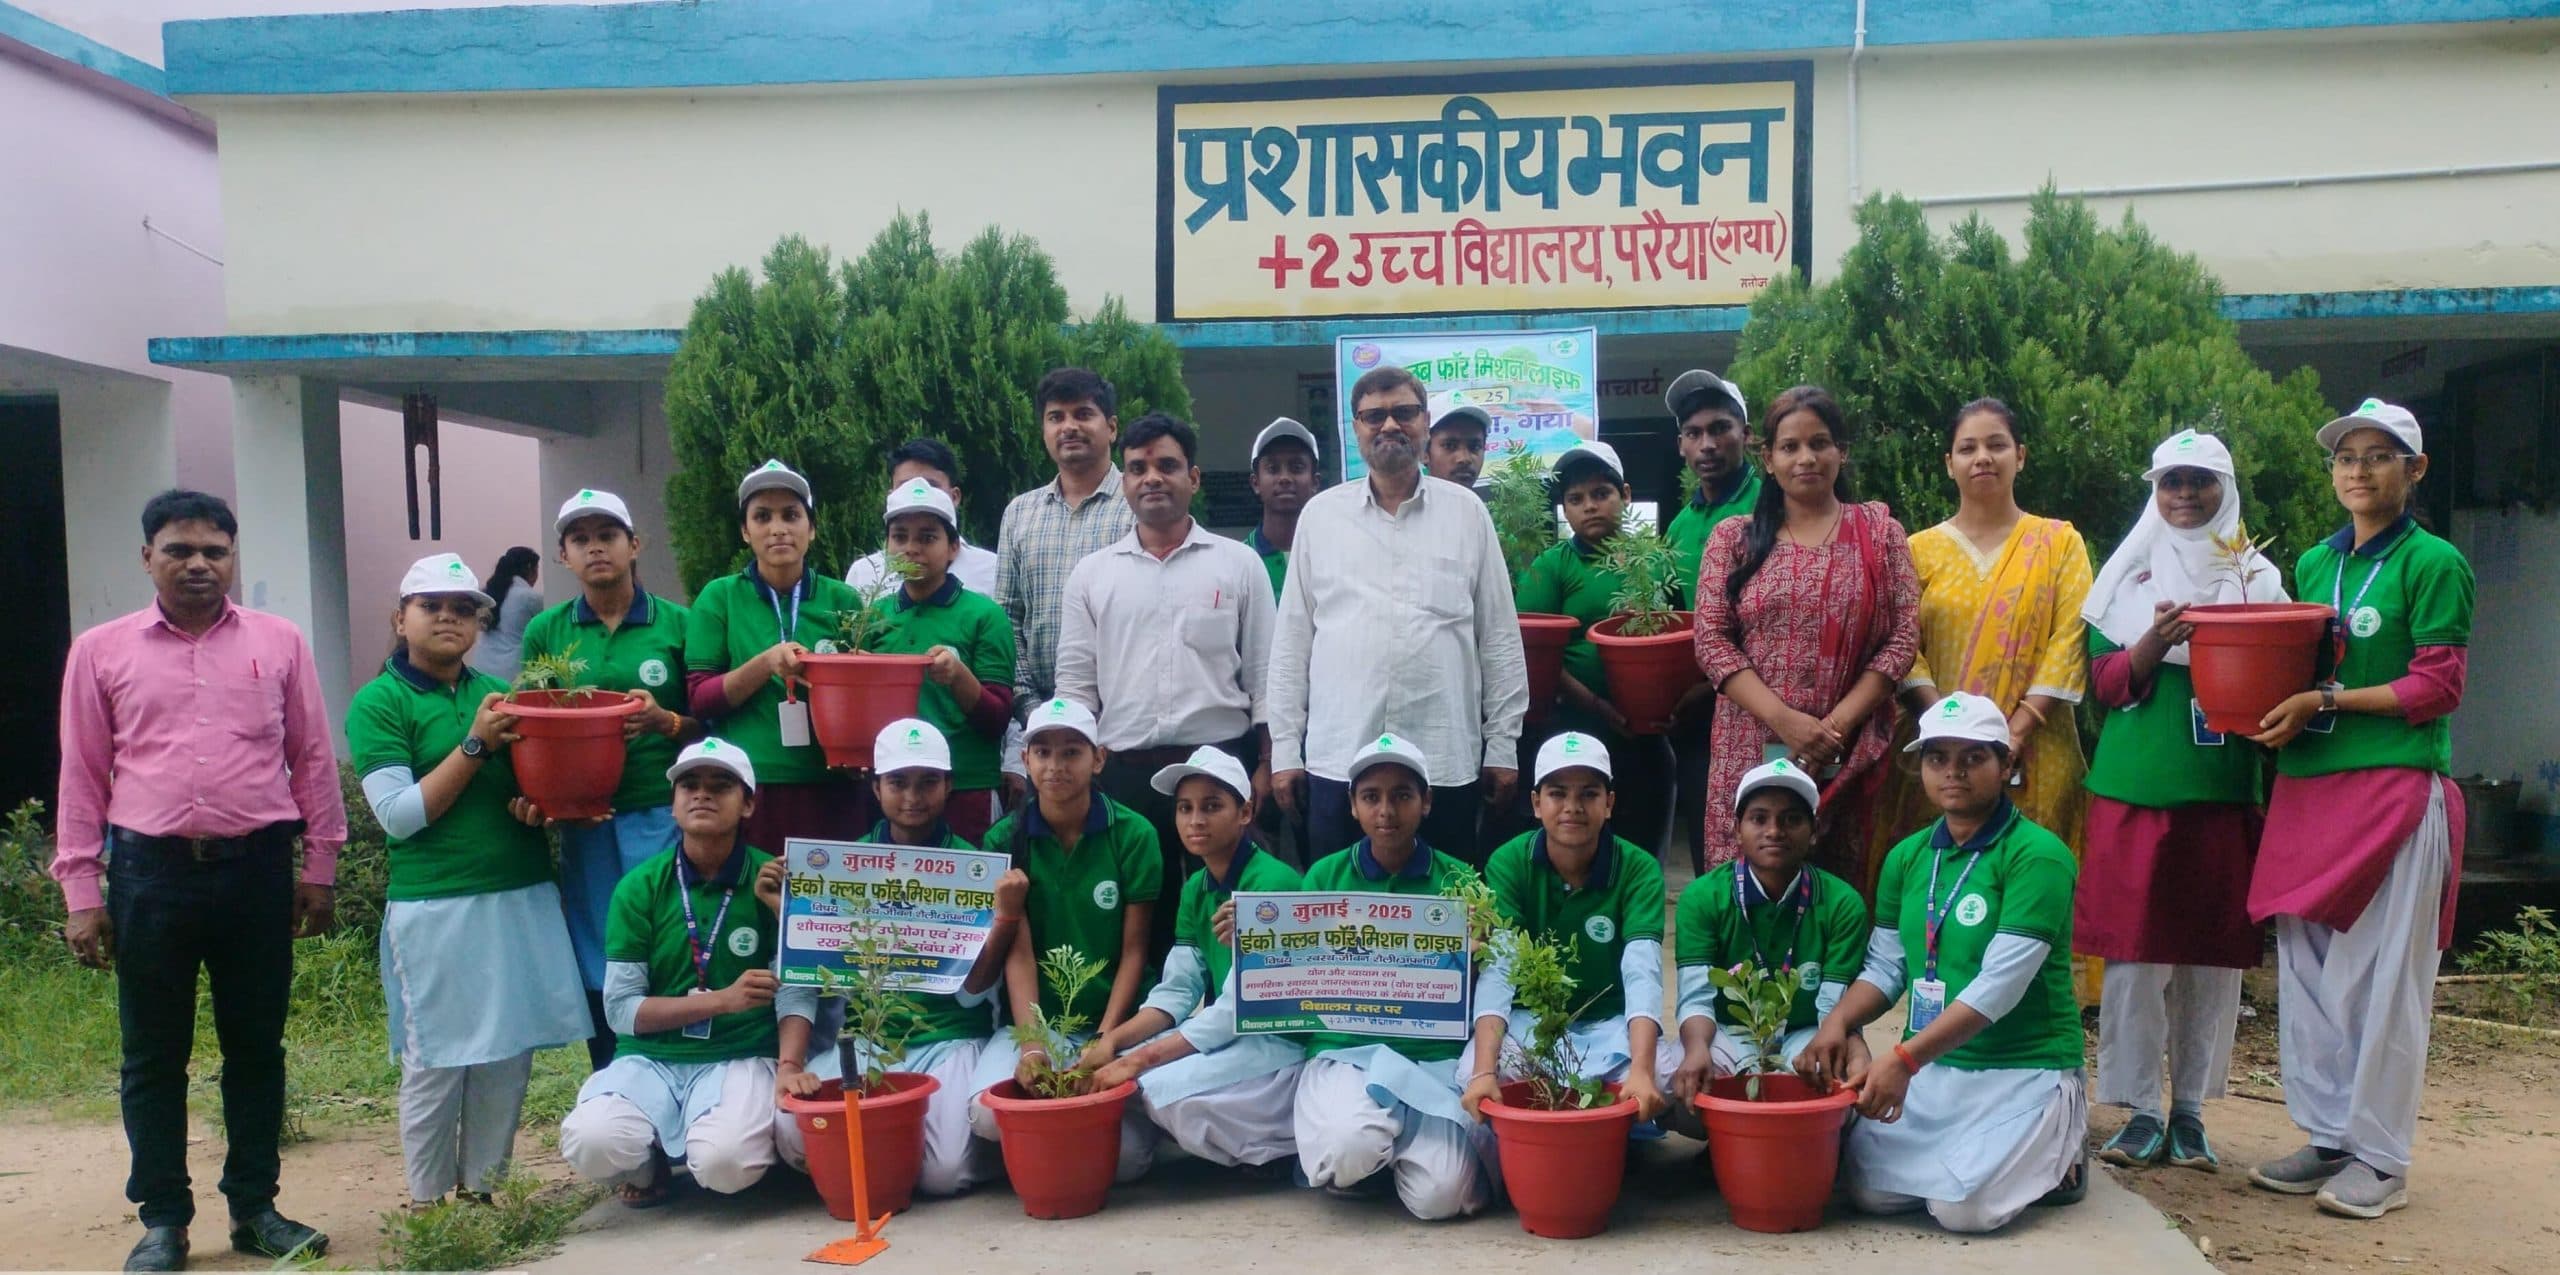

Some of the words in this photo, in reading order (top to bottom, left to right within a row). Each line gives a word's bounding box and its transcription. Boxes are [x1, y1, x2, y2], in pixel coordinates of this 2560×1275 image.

[1567, 107, 1786, 208] भवन
[1258, 233, 1340, 290] +2
[1347, 231, 1446, 287] उच्च
[1437, 351, 1470, 380] फॉर
[1475, 348, 1523, 381] मिशन
[1527, 362, 1581, 390] लाइफ
[1517, 412, 1574, 431] गया
[842, 851, 897, 873] जुलाई
[914, 858, 956, 874] 2025
[790, 871, 824, 897] ईको
[829, 880, 867, 898] क्लब
[871, 878, 903, 901] फॉर
[906, 879, 950, 904] मिशन
[812, 902, 839, 913] विषय
[1291, 898, 1350, 923] जुलाई
[1368, 903, 1413, 920] 2025
[929, 927, 951, 940] एवं
[952, 931, 986, 943] उसके
[1240, 927, 1276, 954] ईको
[1280, 930, 1321, 949] क्लब
[1324, 924, 1358, 947] फॉर
[1361, 924, 1410, 949] मिशन
[1413, 933, 1464, 953] लाइफ
[1265, 955, 1292, 965] विषय
[1307, 967, 1326, 977] योग
[1328, 967, 1346, 977] और
[1348, 969, 1379, 978] व्यायाम
[1382, 969, 1397, 978] सत्र
[1245, 979, 1284, 990] मानसिक
[1285, 987, 1313, 998] परिसर
[1300, 1000, 1352, 1012] विद्यालय
[1354, 1003, 1381, 1014] स्तर
[1384, 1005, 1403, 1016] पर
